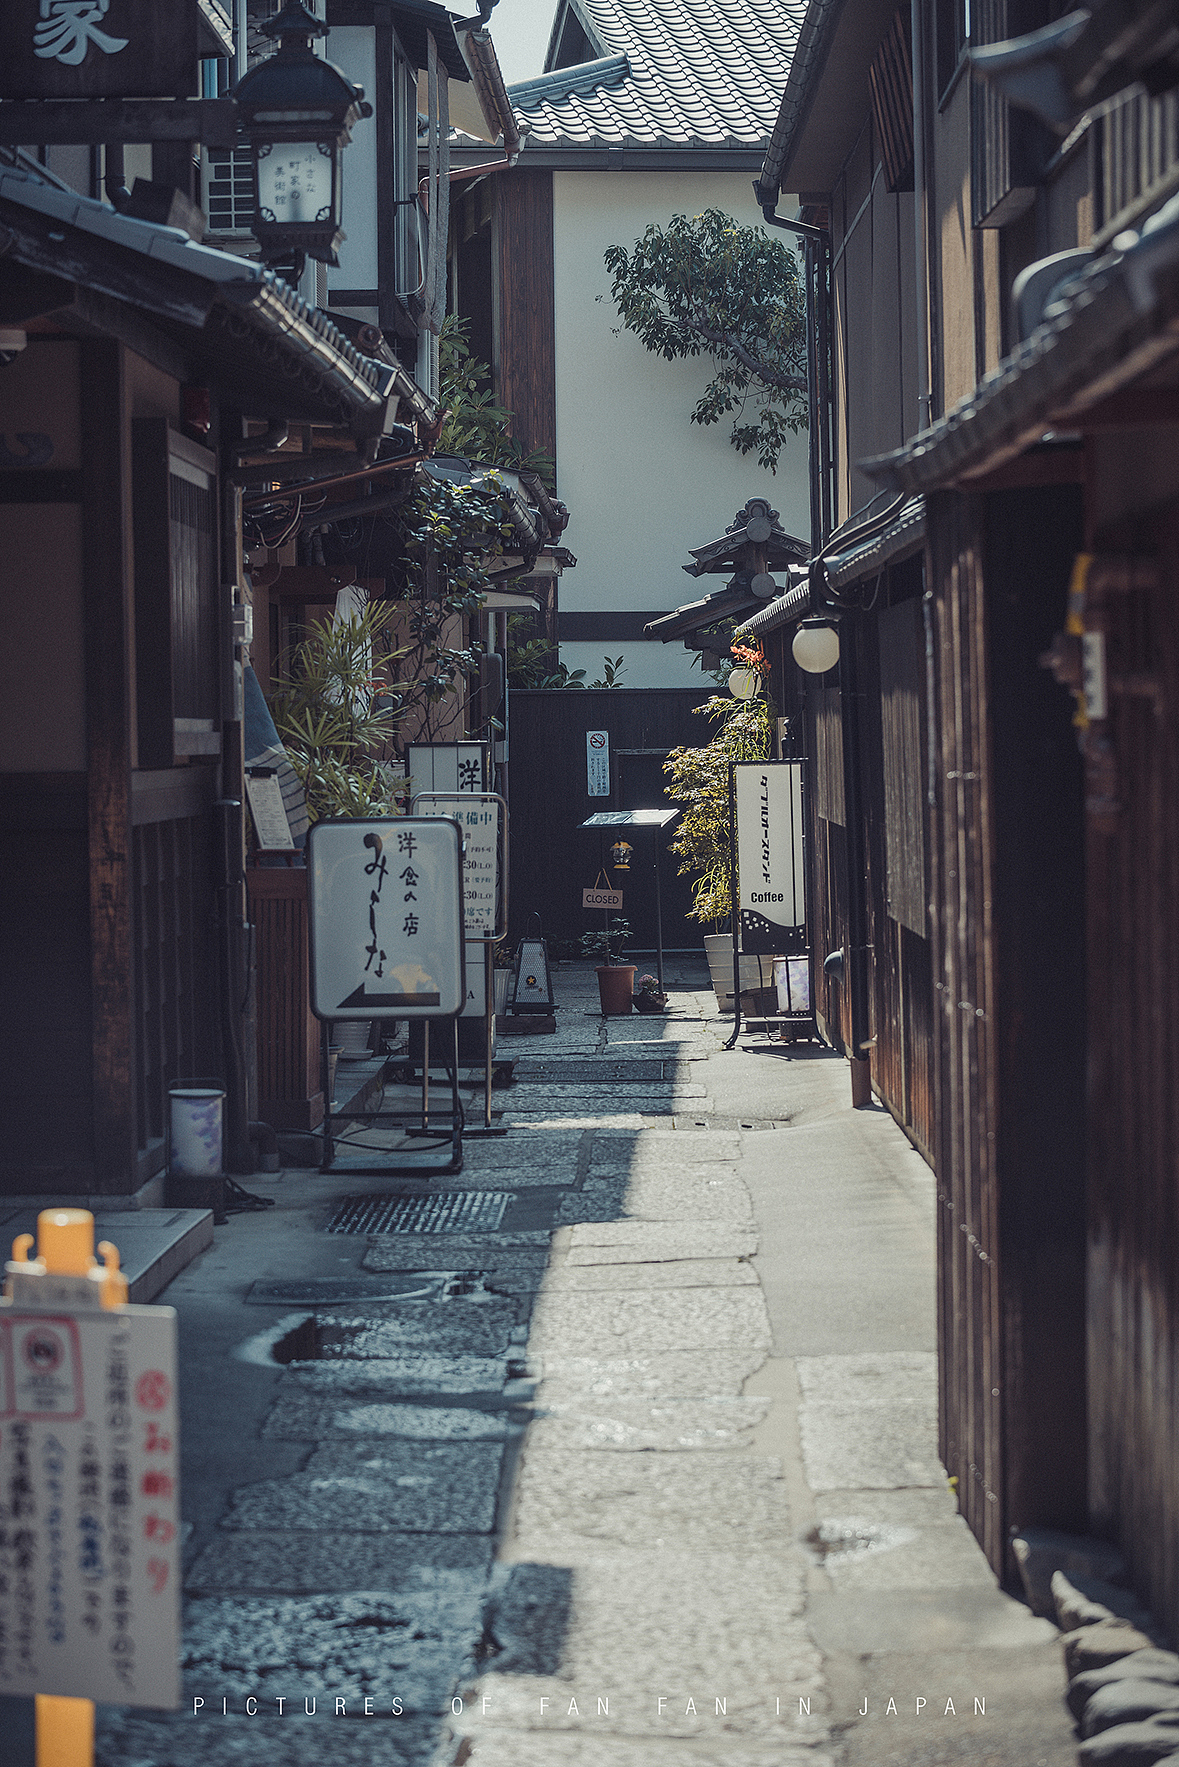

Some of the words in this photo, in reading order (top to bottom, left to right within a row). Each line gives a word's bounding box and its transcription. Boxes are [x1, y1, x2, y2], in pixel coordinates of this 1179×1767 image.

[274, 166, 287, 205] 美術館
[289, 161, 301, 200] 町家の
[303, 154, 316, 193] 小さな
[458, 759, 481, 792] 洋
[398, 832, 419, 937] 洋食の店
[585, 894, 619, 904] CLOSED
[751, 892, 784, 902] Coffee
